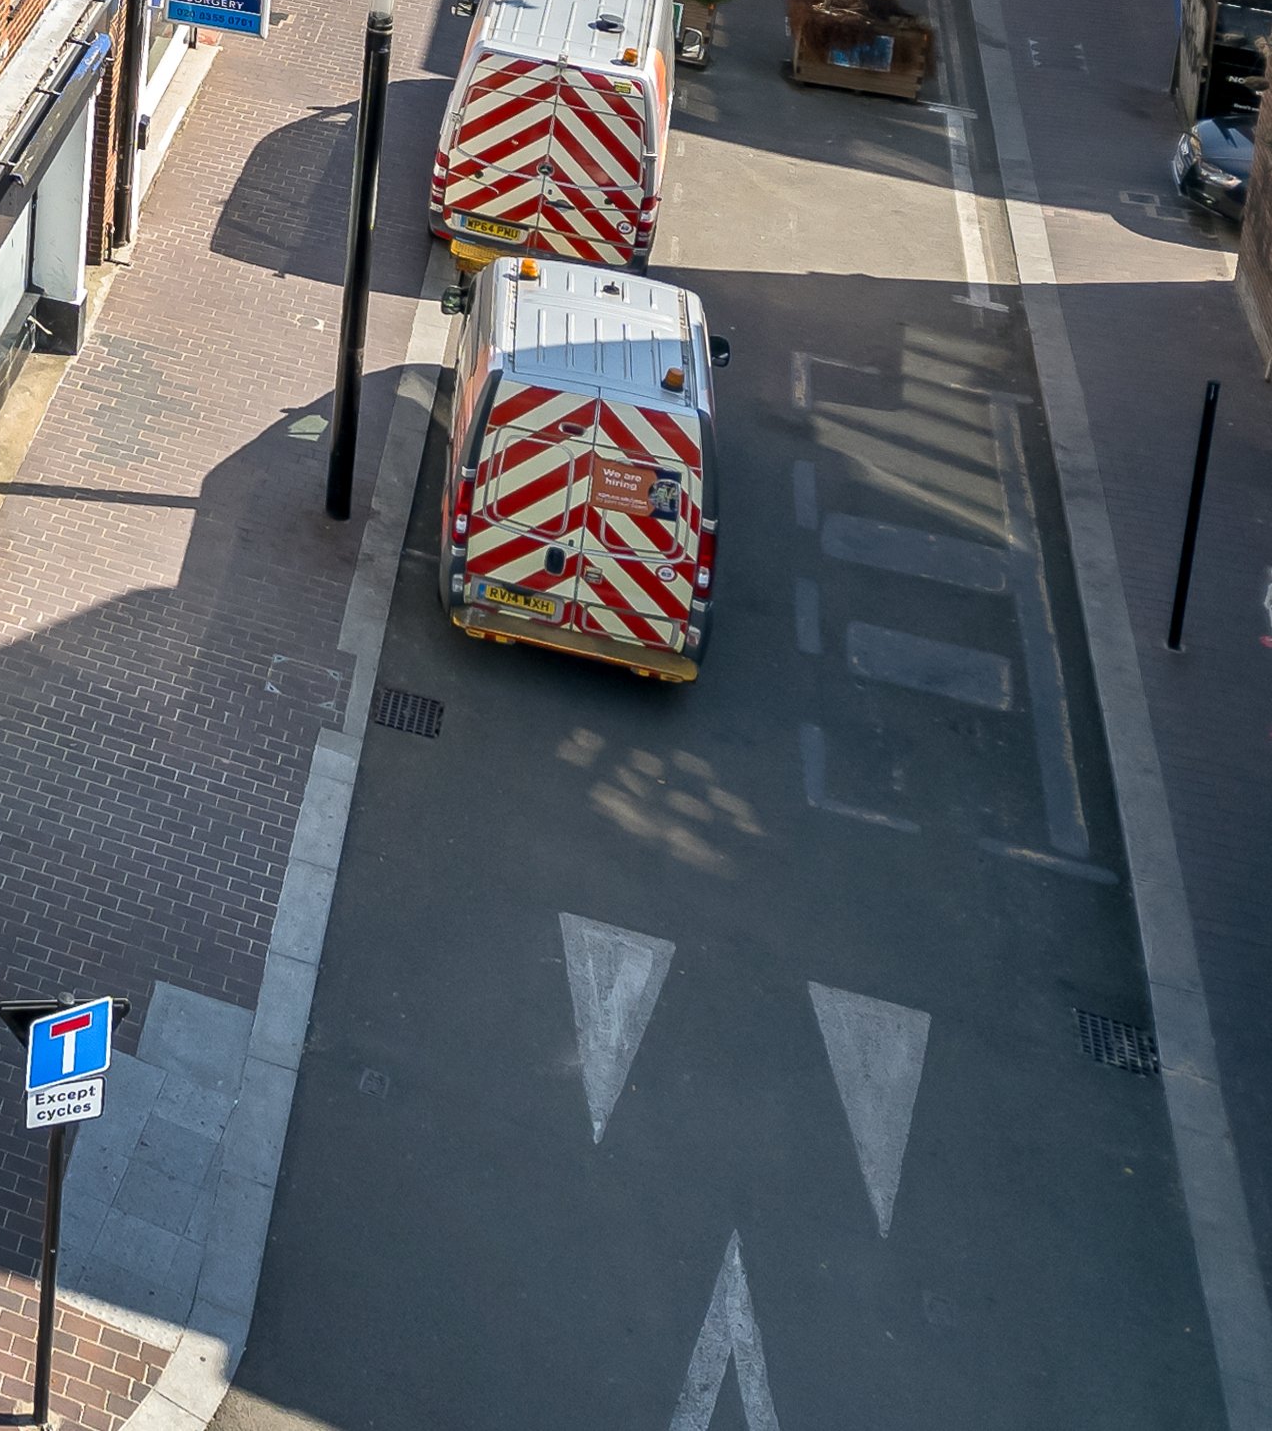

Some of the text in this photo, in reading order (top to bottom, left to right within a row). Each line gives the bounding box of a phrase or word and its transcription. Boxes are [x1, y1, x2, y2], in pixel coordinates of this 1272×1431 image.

[603, 469, 642, 482] We are
[605, 478, 638, 491] hiring
[490, 587, 518, 603] RV14
[35, 1086, 96, 1106] Except
[37, 1103, 92, 1121] cycles
